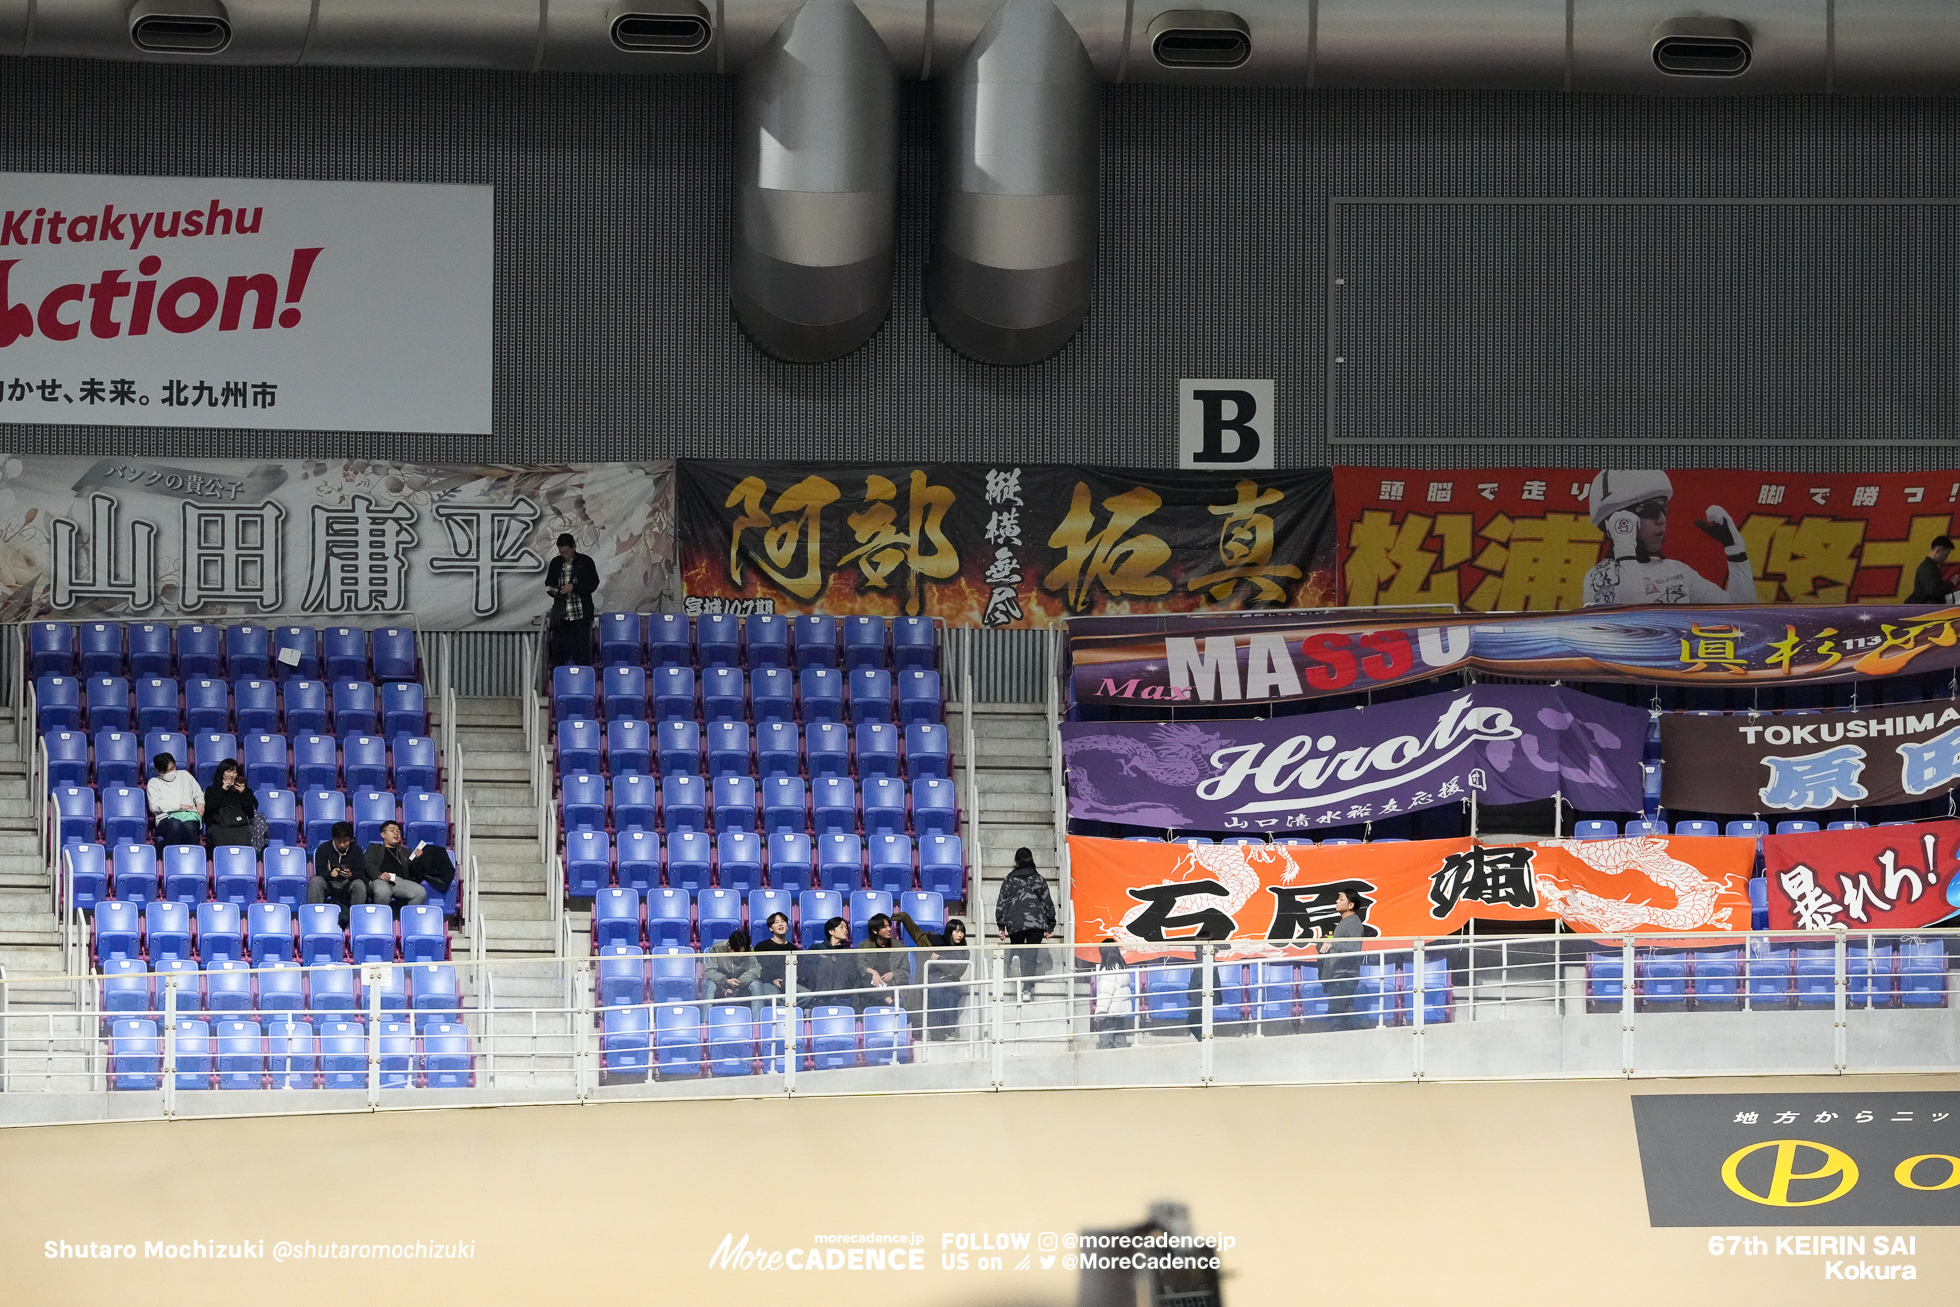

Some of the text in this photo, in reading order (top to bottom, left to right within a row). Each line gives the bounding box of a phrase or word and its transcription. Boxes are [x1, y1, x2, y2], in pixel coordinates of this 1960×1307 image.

[1, 200, 264, 249] Kitakyushu
[0, 378, 278, 409] かせ、未来。 北九州市
[1193, 390, 1260, 463] B
[104, 463, 245, 500] バンクの貴公子
[50, 493, 545, 617] 山田庸平
[725, 469, 1303, 616] 阿部 拓真
[1842, 635, 1883, 650] 113
[1196, 694, 1524, 802] Hiroto
